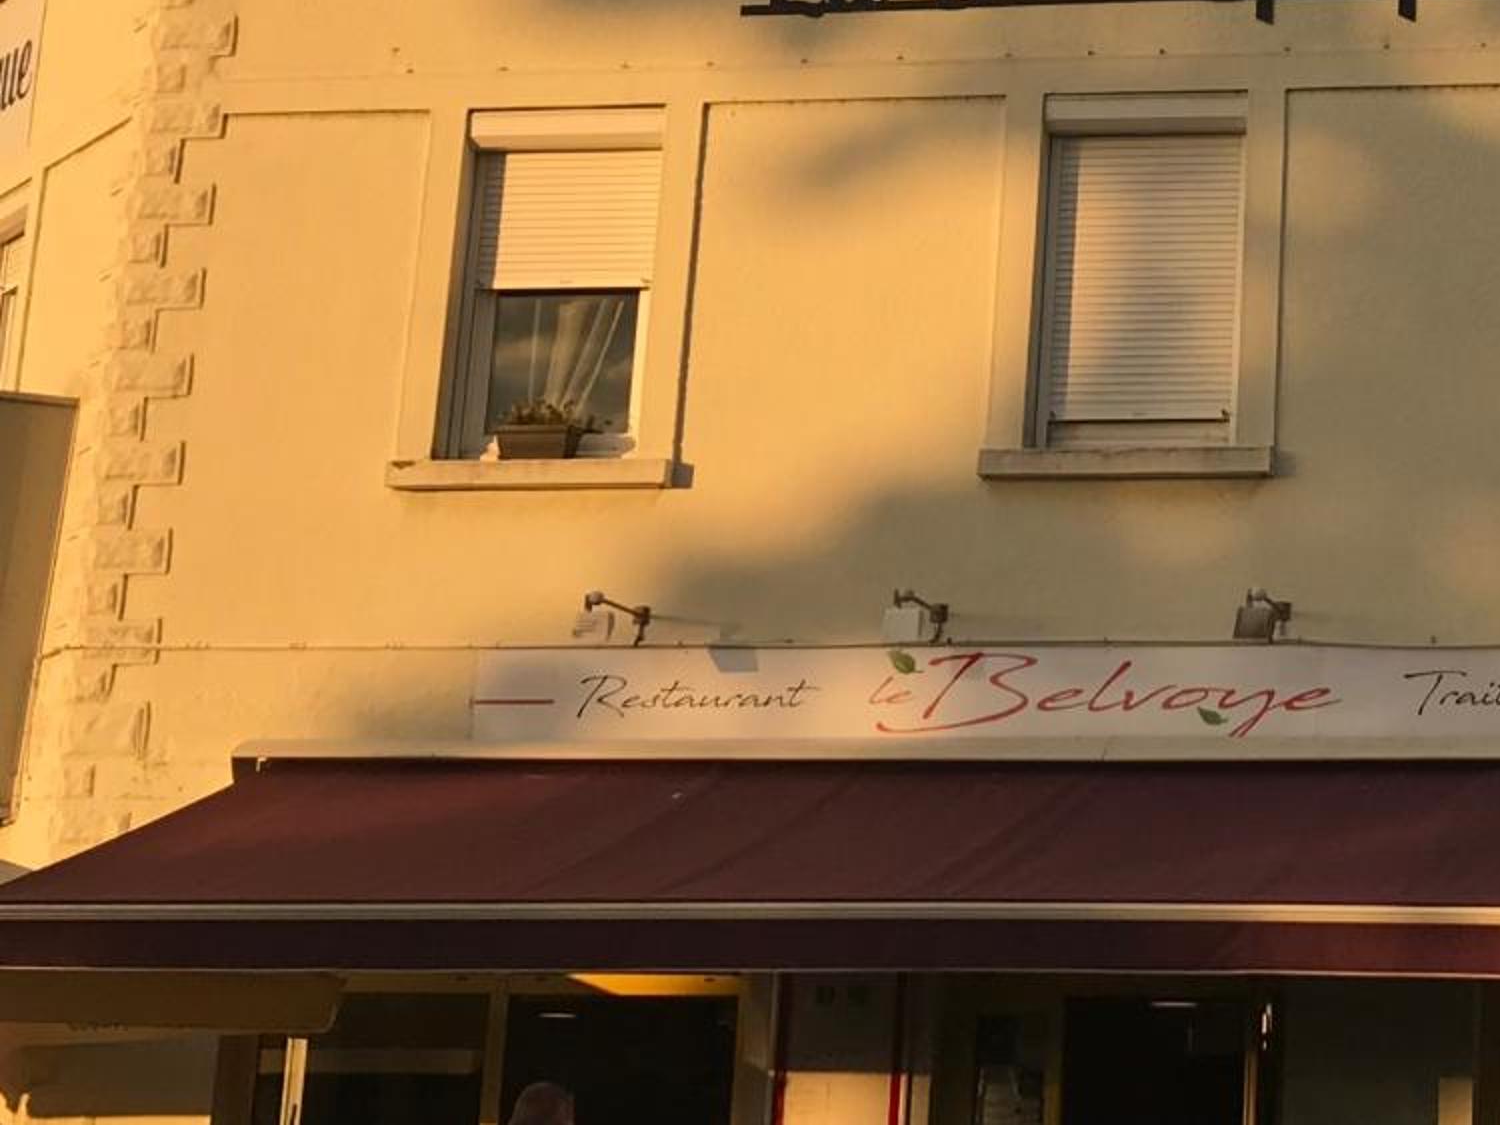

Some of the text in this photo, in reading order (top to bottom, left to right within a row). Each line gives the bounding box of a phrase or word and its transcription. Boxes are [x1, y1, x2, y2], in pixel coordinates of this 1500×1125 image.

[0, 39, 33, 112] ue
[576, 674, 822, 720] Restaurant
[867, 675, 913, 707] le
[876, 651, 1342, 738] Belvoye
